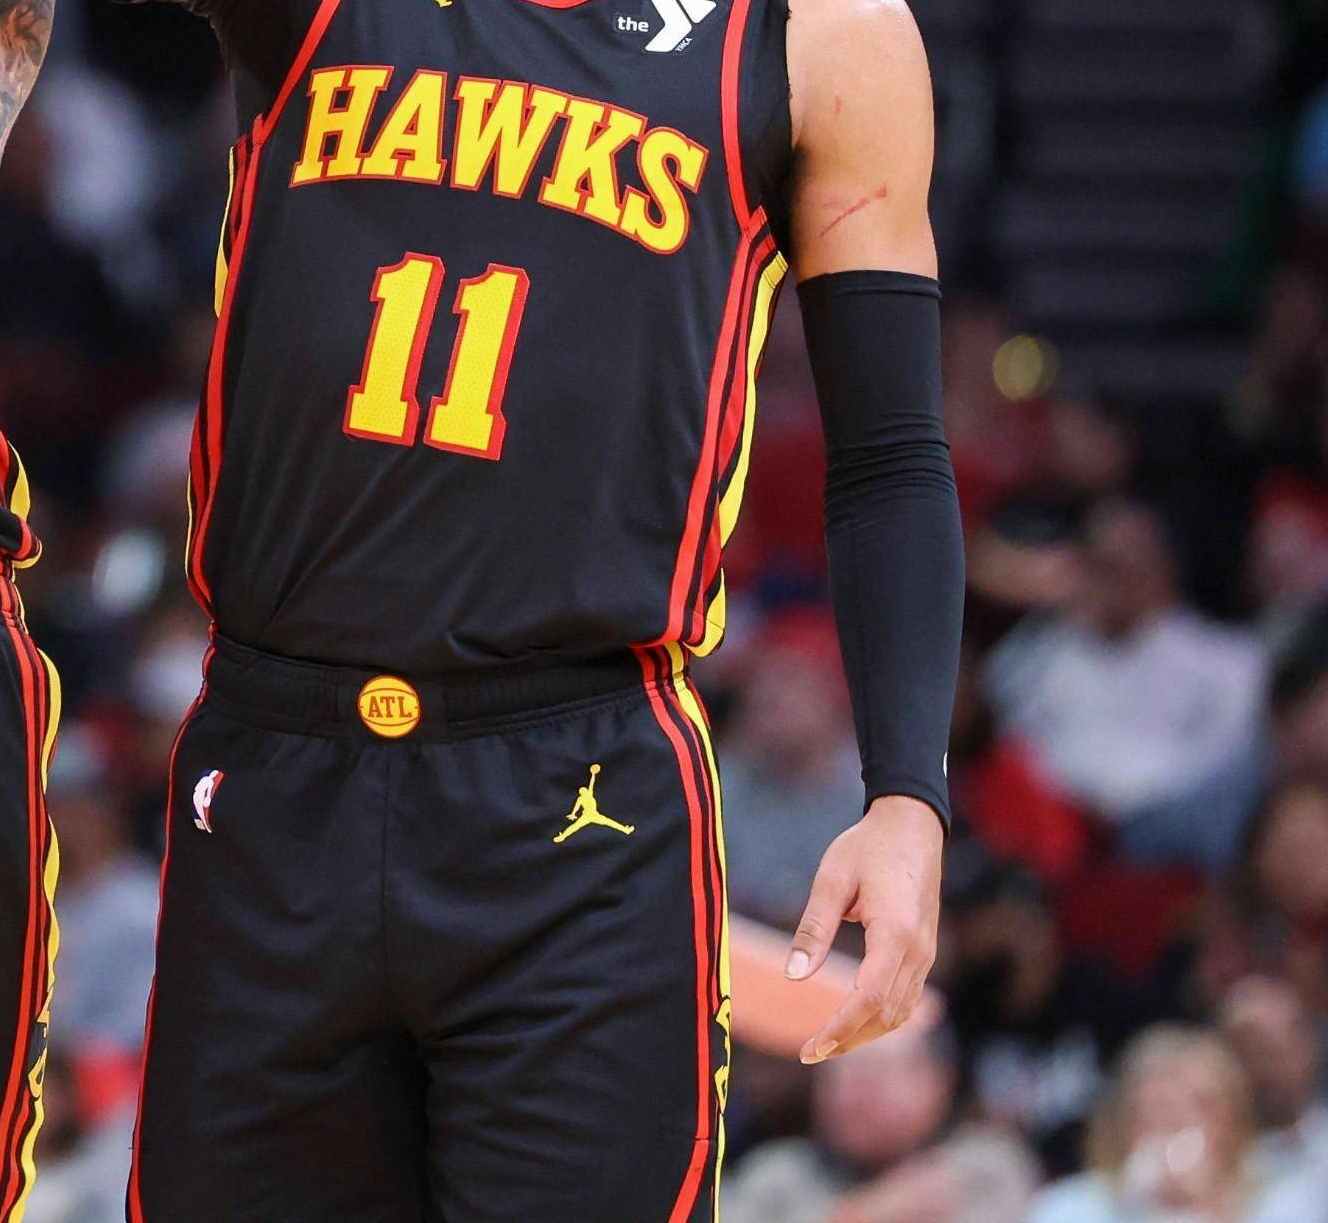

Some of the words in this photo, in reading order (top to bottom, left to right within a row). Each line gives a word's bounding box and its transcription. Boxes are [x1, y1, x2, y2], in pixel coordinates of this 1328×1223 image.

[617, 16, 649, 32] the
[289, 64, 709, 255] HAWKS
[342, 250, 530, 461] 11
[368, 695, 413, 718] ATL
